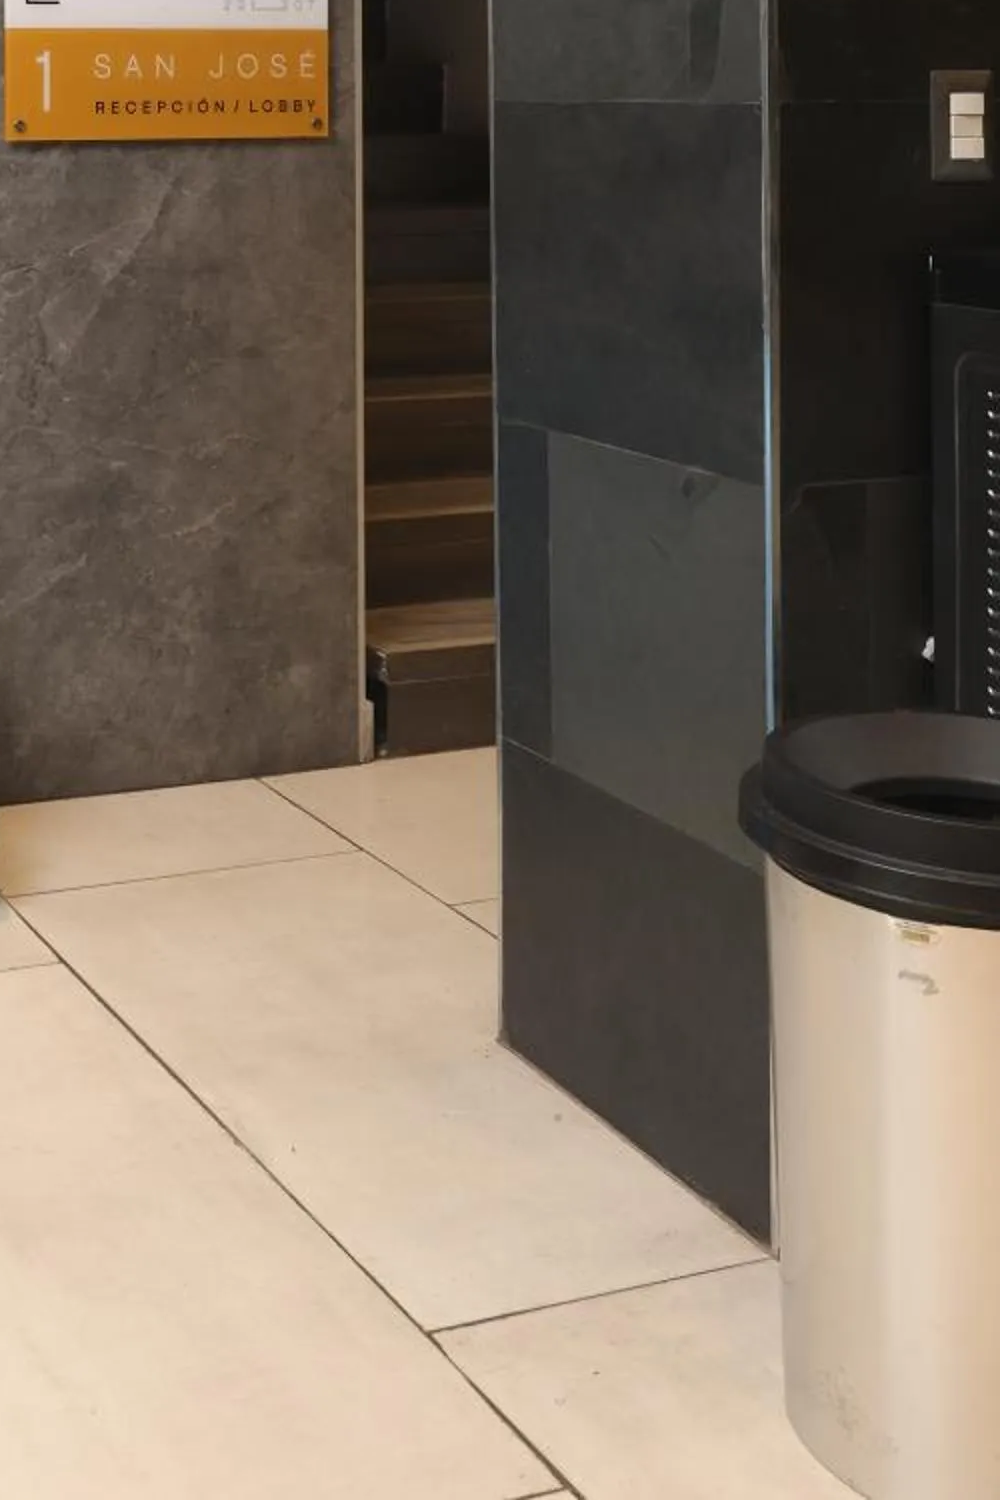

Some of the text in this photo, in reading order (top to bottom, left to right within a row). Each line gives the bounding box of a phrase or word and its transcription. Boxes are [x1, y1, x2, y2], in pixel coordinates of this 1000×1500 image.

[36, 50, 317, 113] 1 SAN JOSÉ
[249, 100, 317, 114] LOBBY
